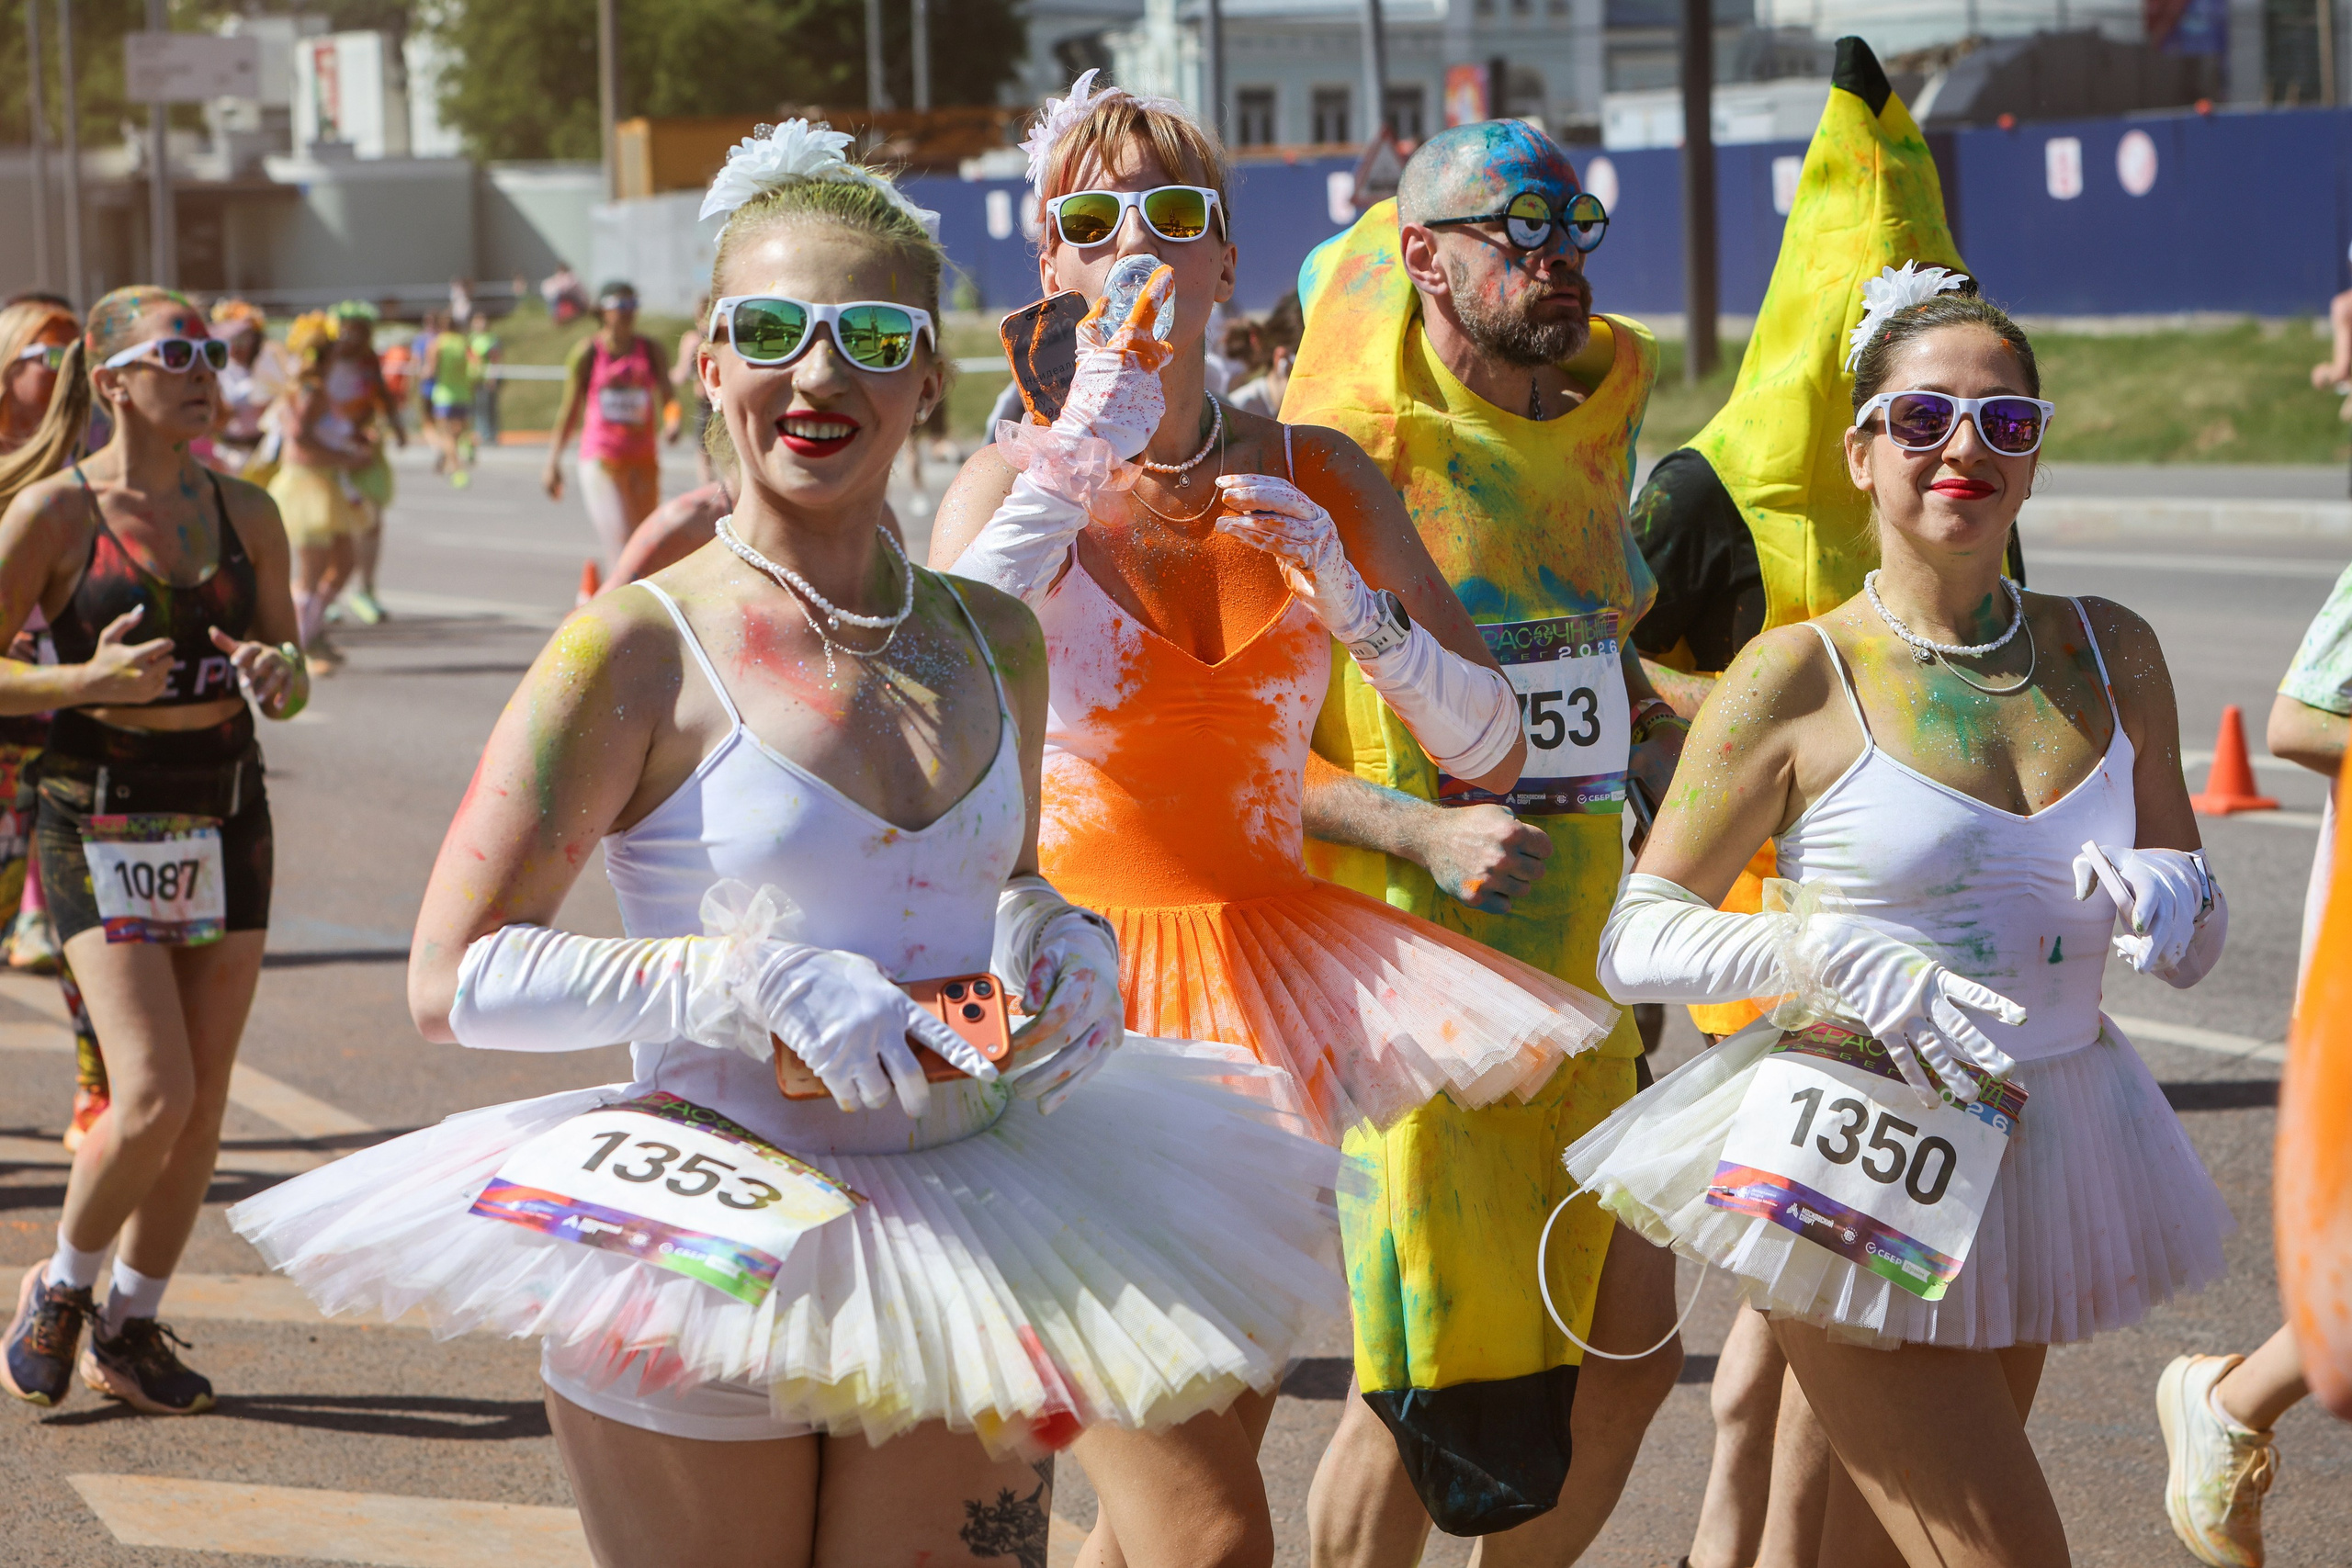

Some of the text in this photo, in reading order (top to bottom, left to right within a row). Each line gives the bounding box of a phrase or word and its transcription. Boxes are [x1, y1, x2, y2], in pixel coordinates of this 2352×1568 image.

[1481, 615, 1609, 650] РАСОЧНЫЙ
[1500, 640, 1618, 662] БЕГ 2026
[1589, 794, 1611, 802] СБЕР
[115, 859, 199, 901] 1087
[1939, 1089, 2009, 1133] 026
[1791, 1087, 1957, 1205] 1350
[582, 1131, 783, 1210] 1353
[1877, 1249, 1903, 1266] СБЕР
